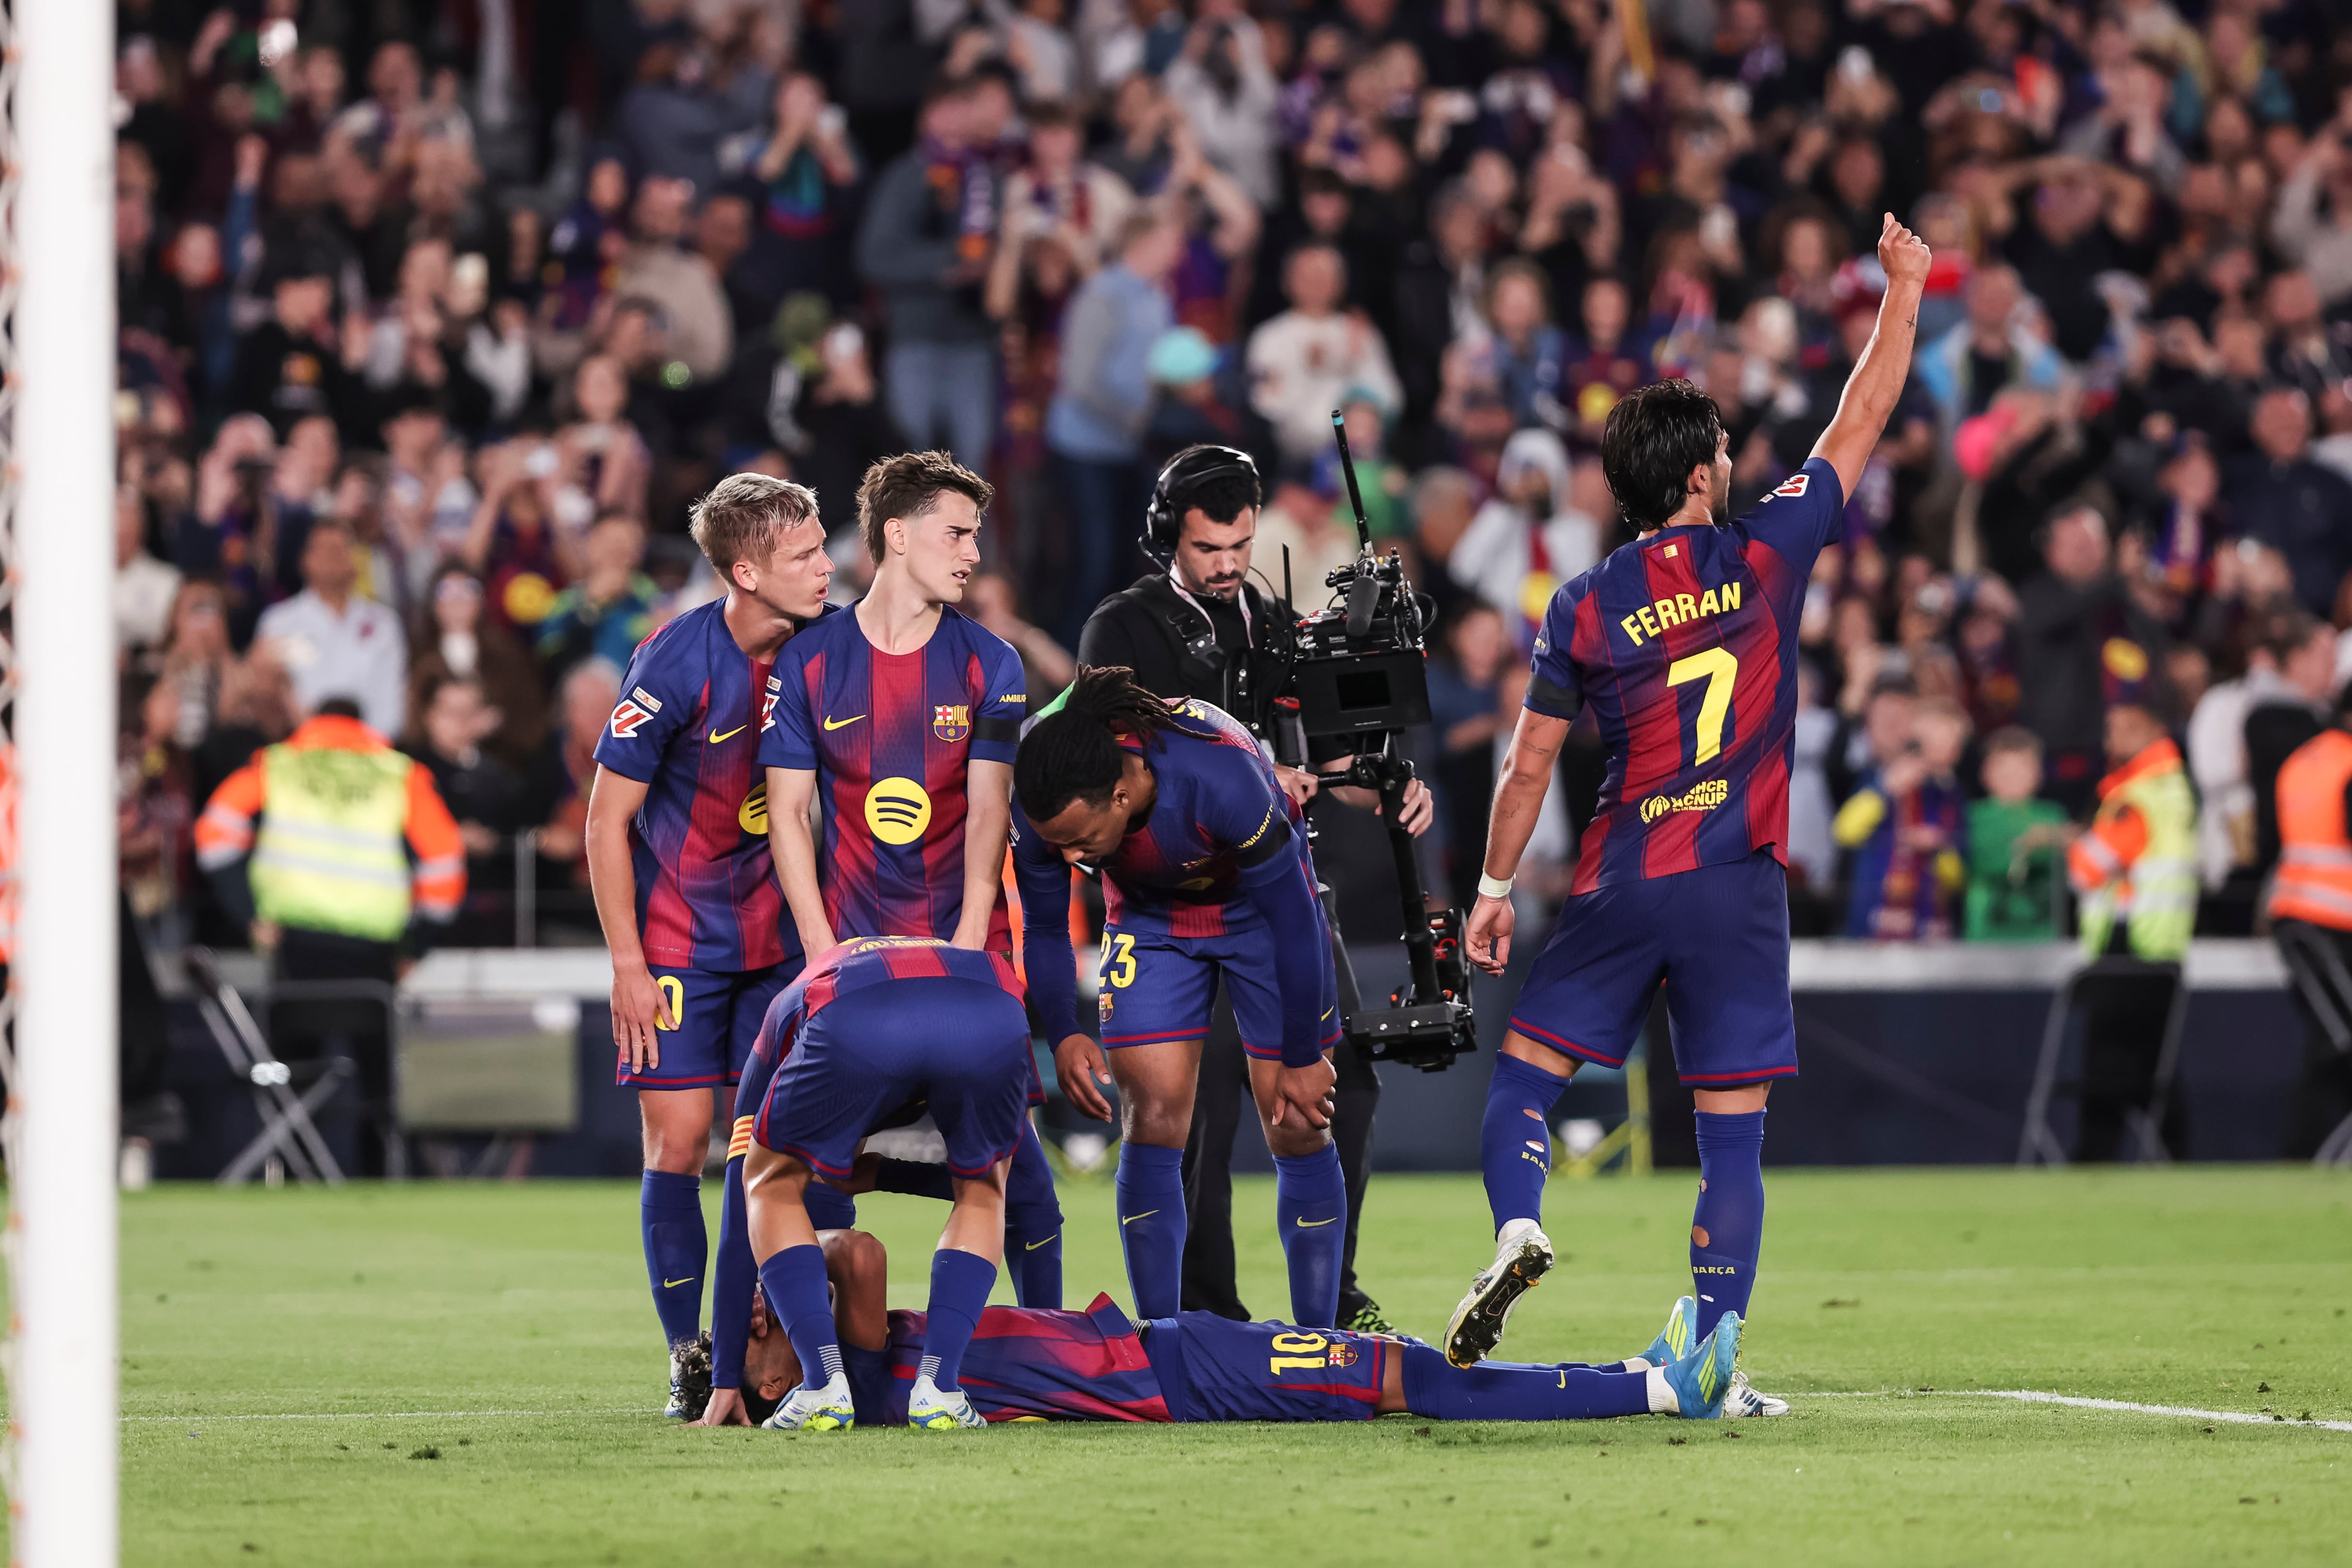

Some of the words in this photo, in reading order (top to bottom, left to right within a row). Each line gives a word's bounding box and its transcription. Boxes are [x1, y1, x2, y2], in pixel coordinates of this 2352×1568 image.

[1621, 582, 1741, 647] FERRAN
[1667, 646, 1738, 767] 7
[1238, 811, 1271, 848] MBILIGHT
[1099, 931, 1137, 988] 23
[655, 975, 684, 1031] 0
[1693, 1266, 1735, 1275] BARÇA
[1270, 1333, 1328, 1376] 10
